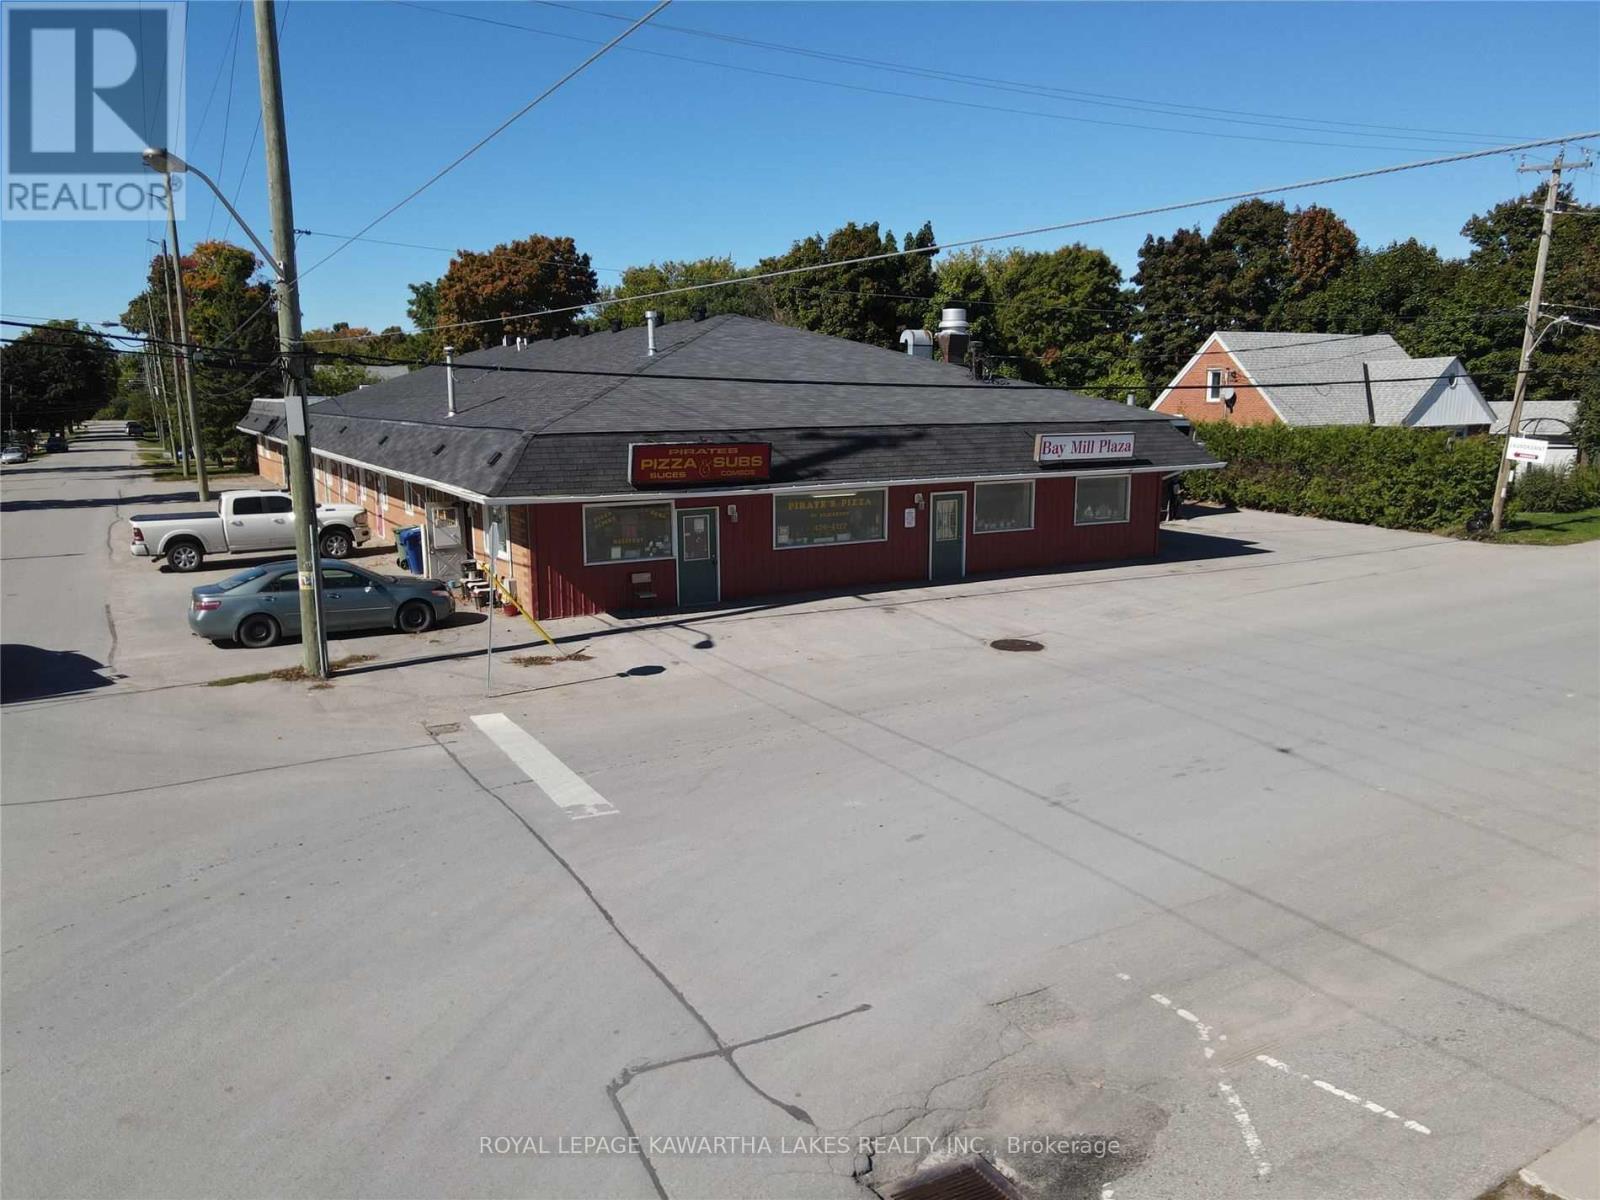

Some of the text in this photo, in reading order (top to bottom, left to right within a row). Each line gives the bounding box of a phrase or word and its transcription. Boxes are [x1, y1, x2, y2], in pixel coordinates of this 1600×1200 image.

[668, 447, 739, 456] PIRATES
[1042, 439, 1131, 457] Bay Mill Plaza
[640, 457, 698, 471] PIZZA
[713, 455, 763, 468] SUBS
[650, 471, 687, 479] SLICES
[840, 498, 872, 508] PIZZA
